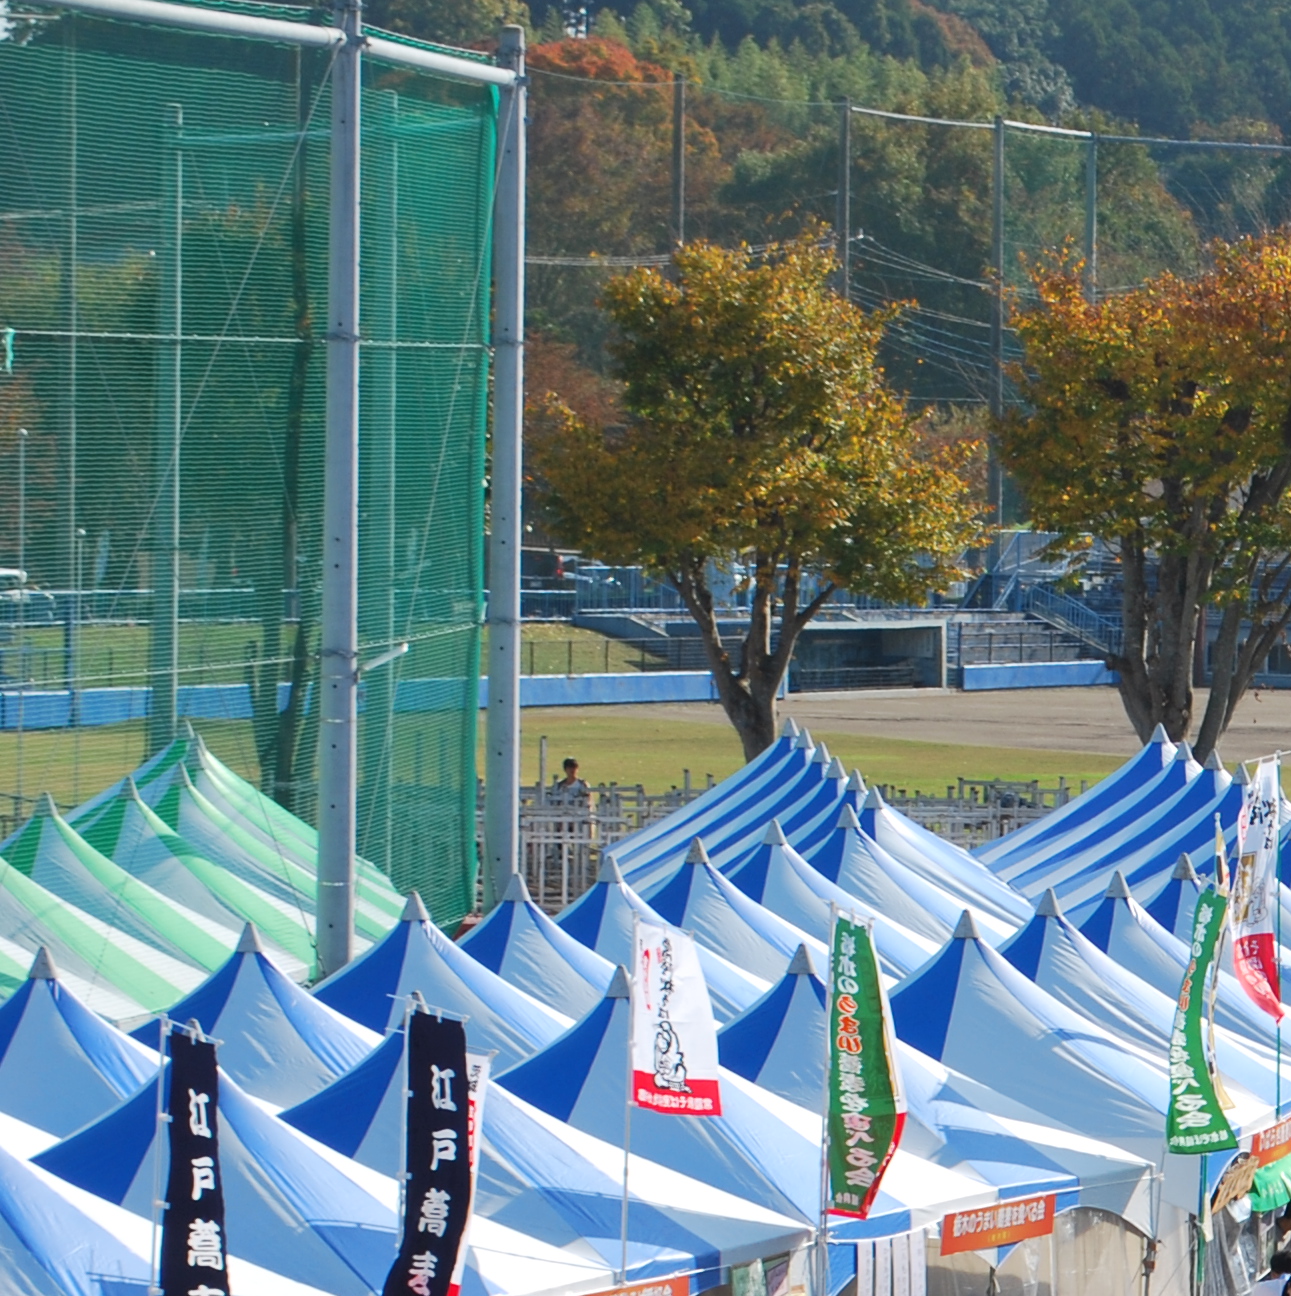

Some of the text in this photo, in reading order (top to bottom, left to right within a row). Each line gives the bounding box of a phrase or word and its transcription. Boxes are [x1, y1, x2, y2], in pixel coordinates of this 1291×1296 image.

[953, 1199, 1047, 1238] 栃木のうまい蕎麦を食べる会
